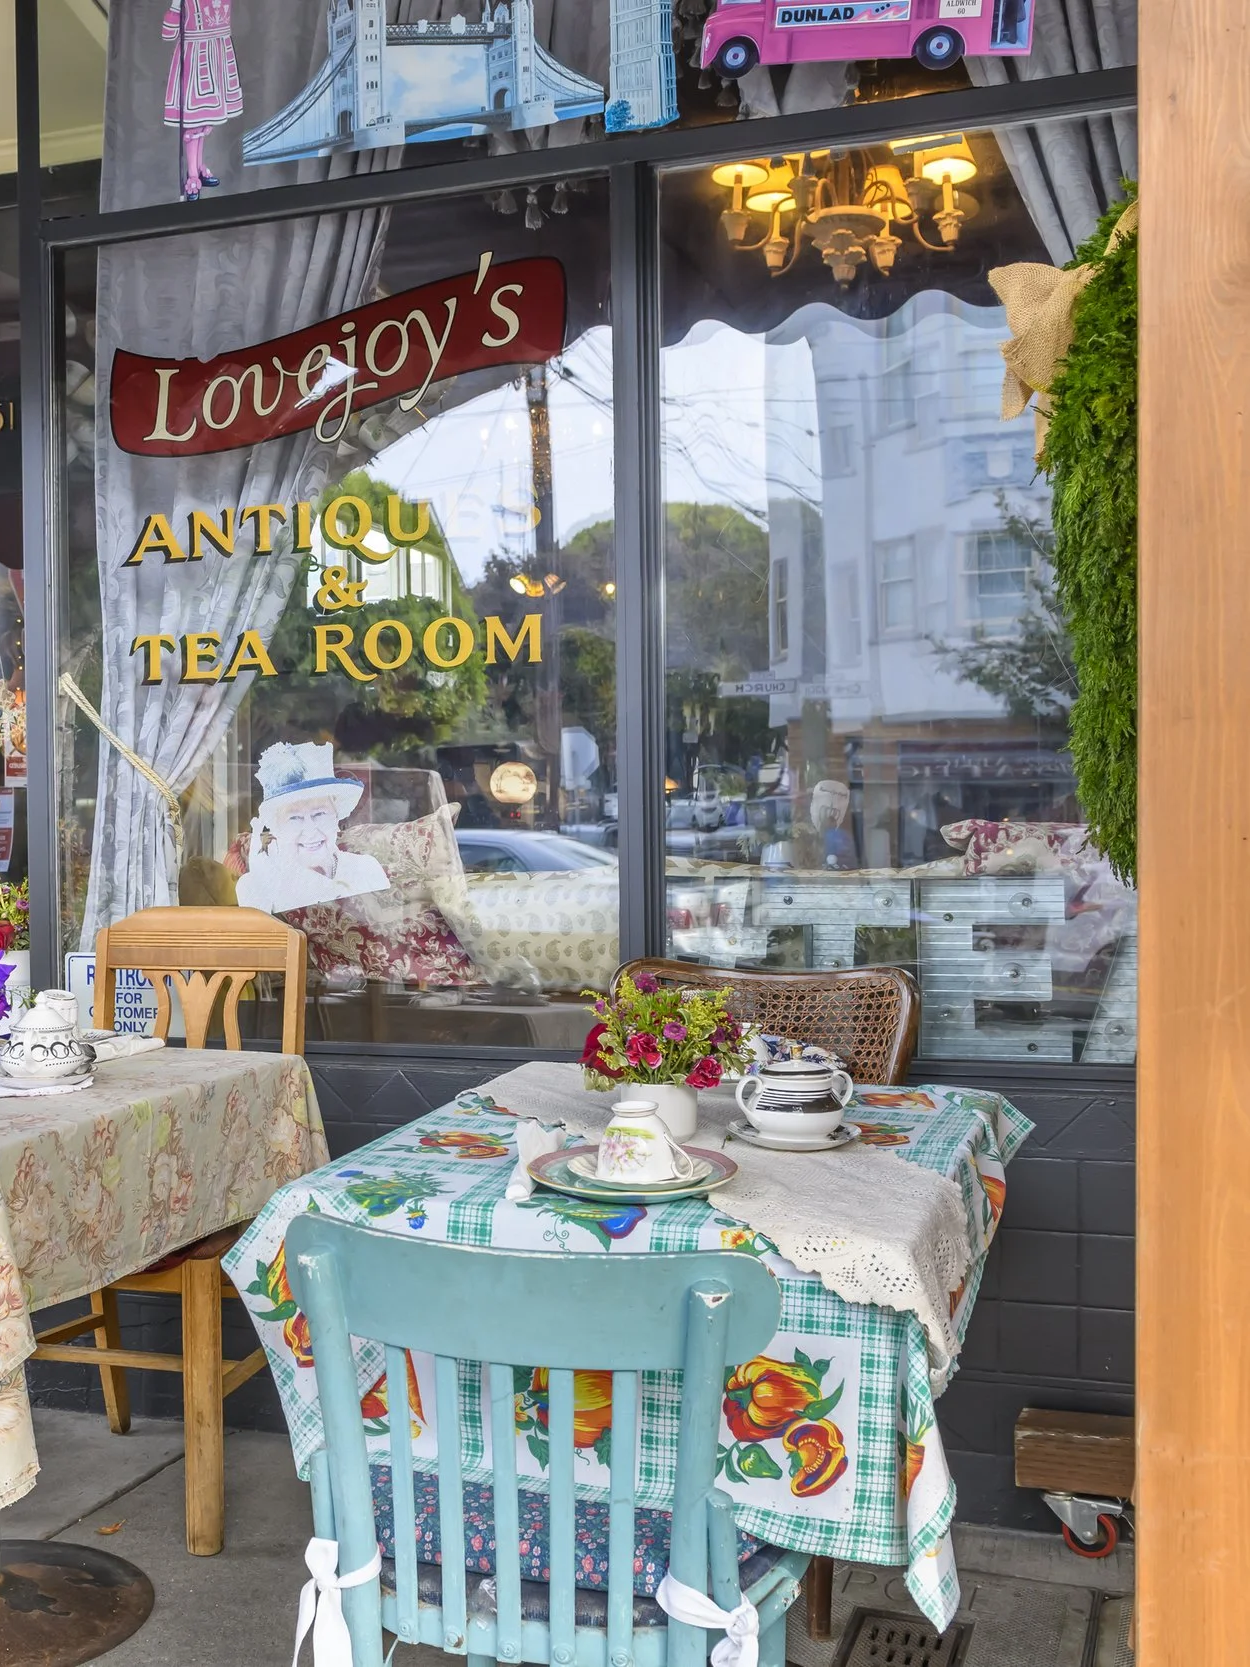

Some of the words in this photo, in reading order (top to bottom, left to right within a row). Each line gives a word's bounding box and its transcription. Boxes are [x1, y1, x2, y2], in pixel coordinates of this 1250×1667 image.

[781, 7, 855, 23] DUNLAD
[143, 251, 525, 444] Lovejoy's
[313, 565, 368, 615] &
[130, 629, 279, 686] TEA
[311, 613, 543, 684] ROOM
[116, 992, 143, 1004] FOR
[114, 1021, 147, 1033] ONLY
